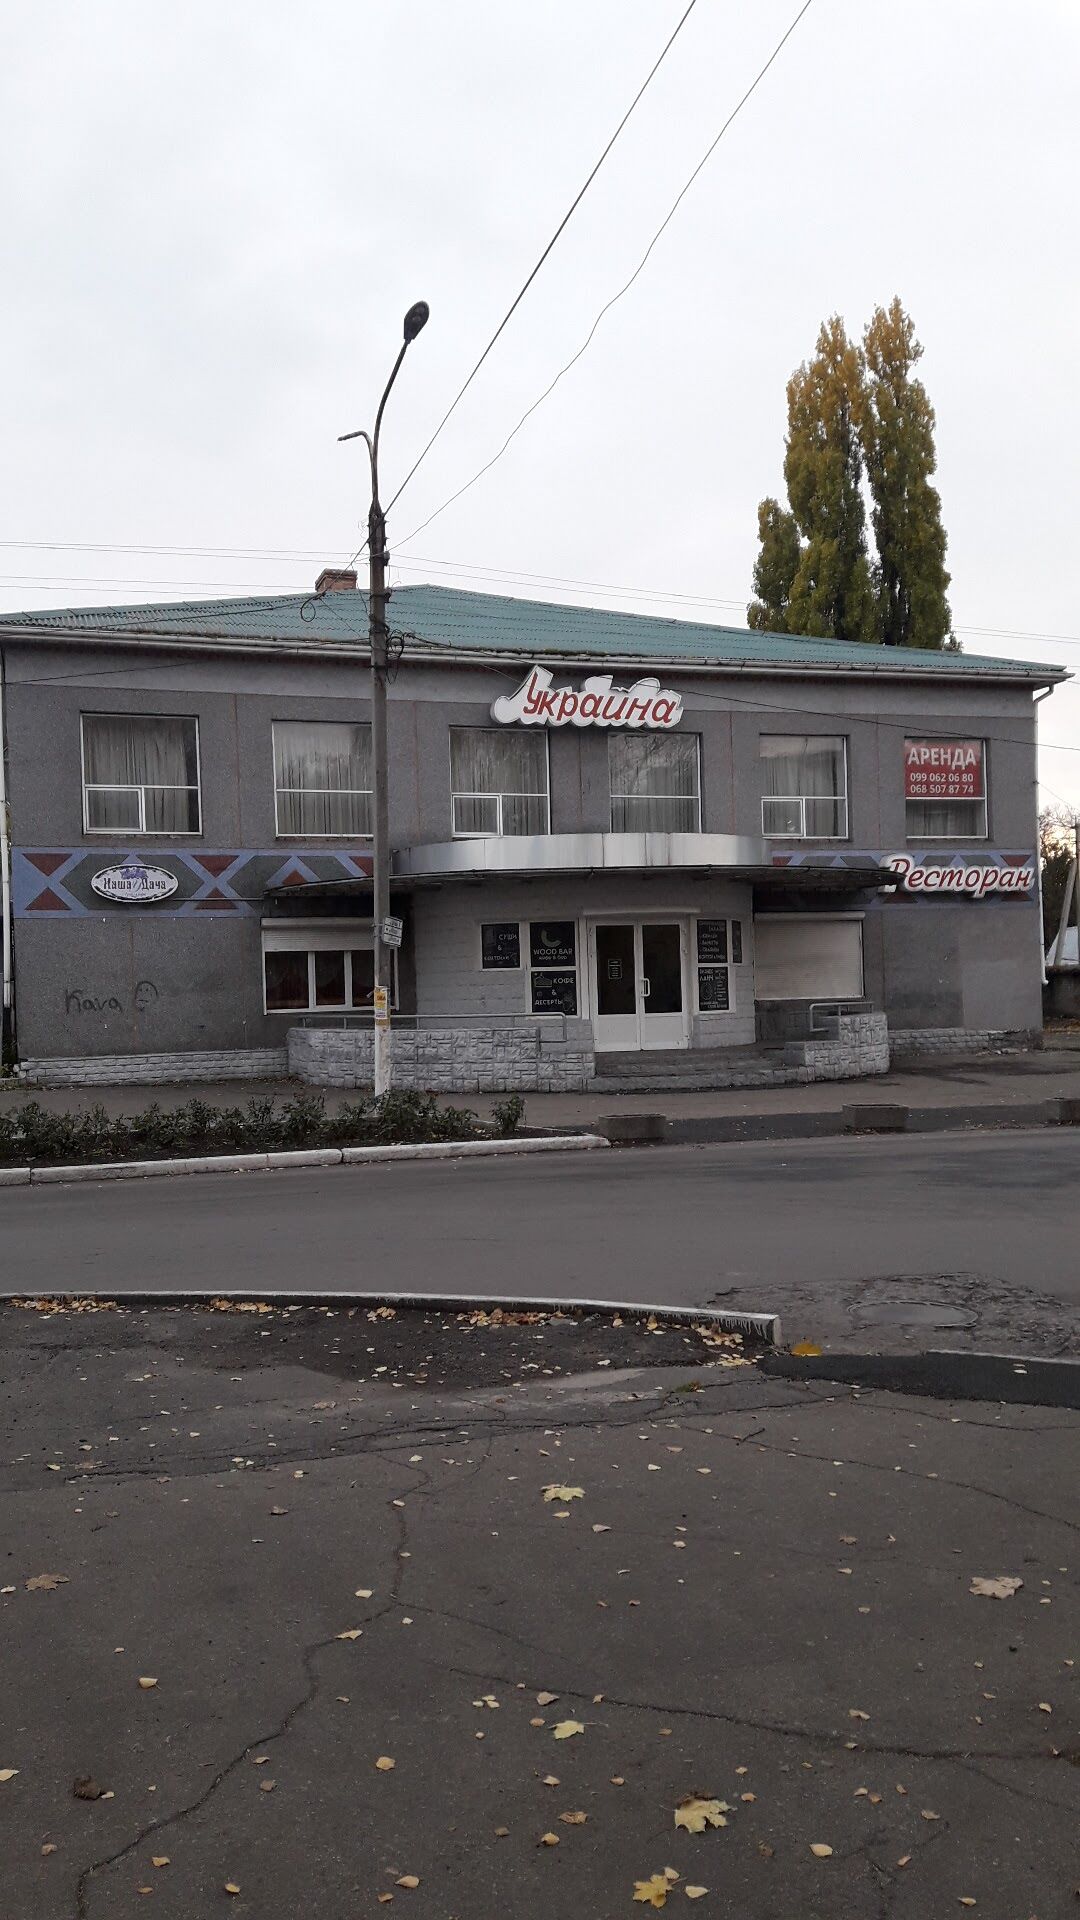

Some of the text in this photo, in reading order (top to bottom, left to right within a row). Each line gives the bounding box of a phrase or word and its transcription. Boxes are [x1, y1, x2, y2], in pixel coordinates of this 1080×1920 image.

[523, 671, 677, 723] Украина
[907, 747, 977, 770] АРЕНДА
[910, 773, 973, 782] 099 062 06 80
[910, 784, 974, 794] 068 507 87 74
[891, 858, 1031, 895] Ресторан
[103, 878, 167, 891] Наша Дача
[533, 947, 573, 956] WOOD BAR
